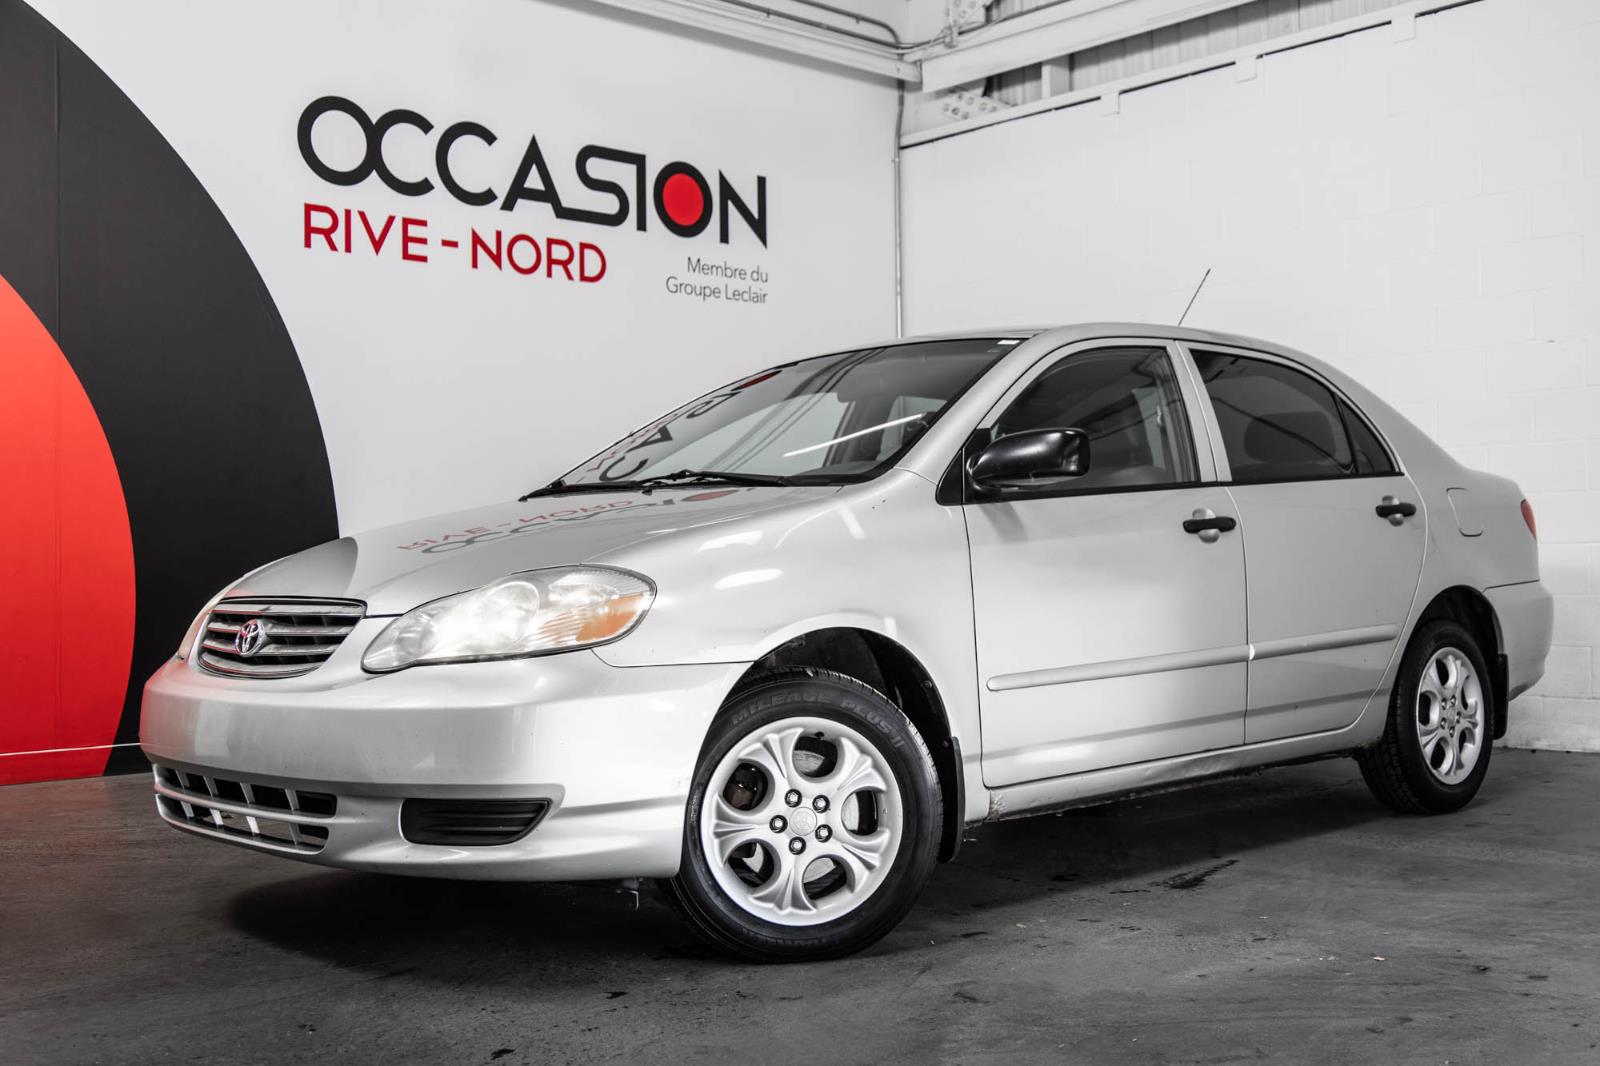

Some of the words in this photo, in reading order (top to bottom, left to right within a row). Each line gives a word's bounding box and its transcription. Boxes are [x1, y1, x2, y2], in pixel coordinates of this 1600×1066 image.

[297, 95, 768, 249] OCCASION
[687, 256, 747, 281] Membre
[750, 265, 769, 284] du
[665, 276, 722, 302] Groupe
[725, 283, 769, 304] Leclair
[839, 698, 894, 735] PLUS
